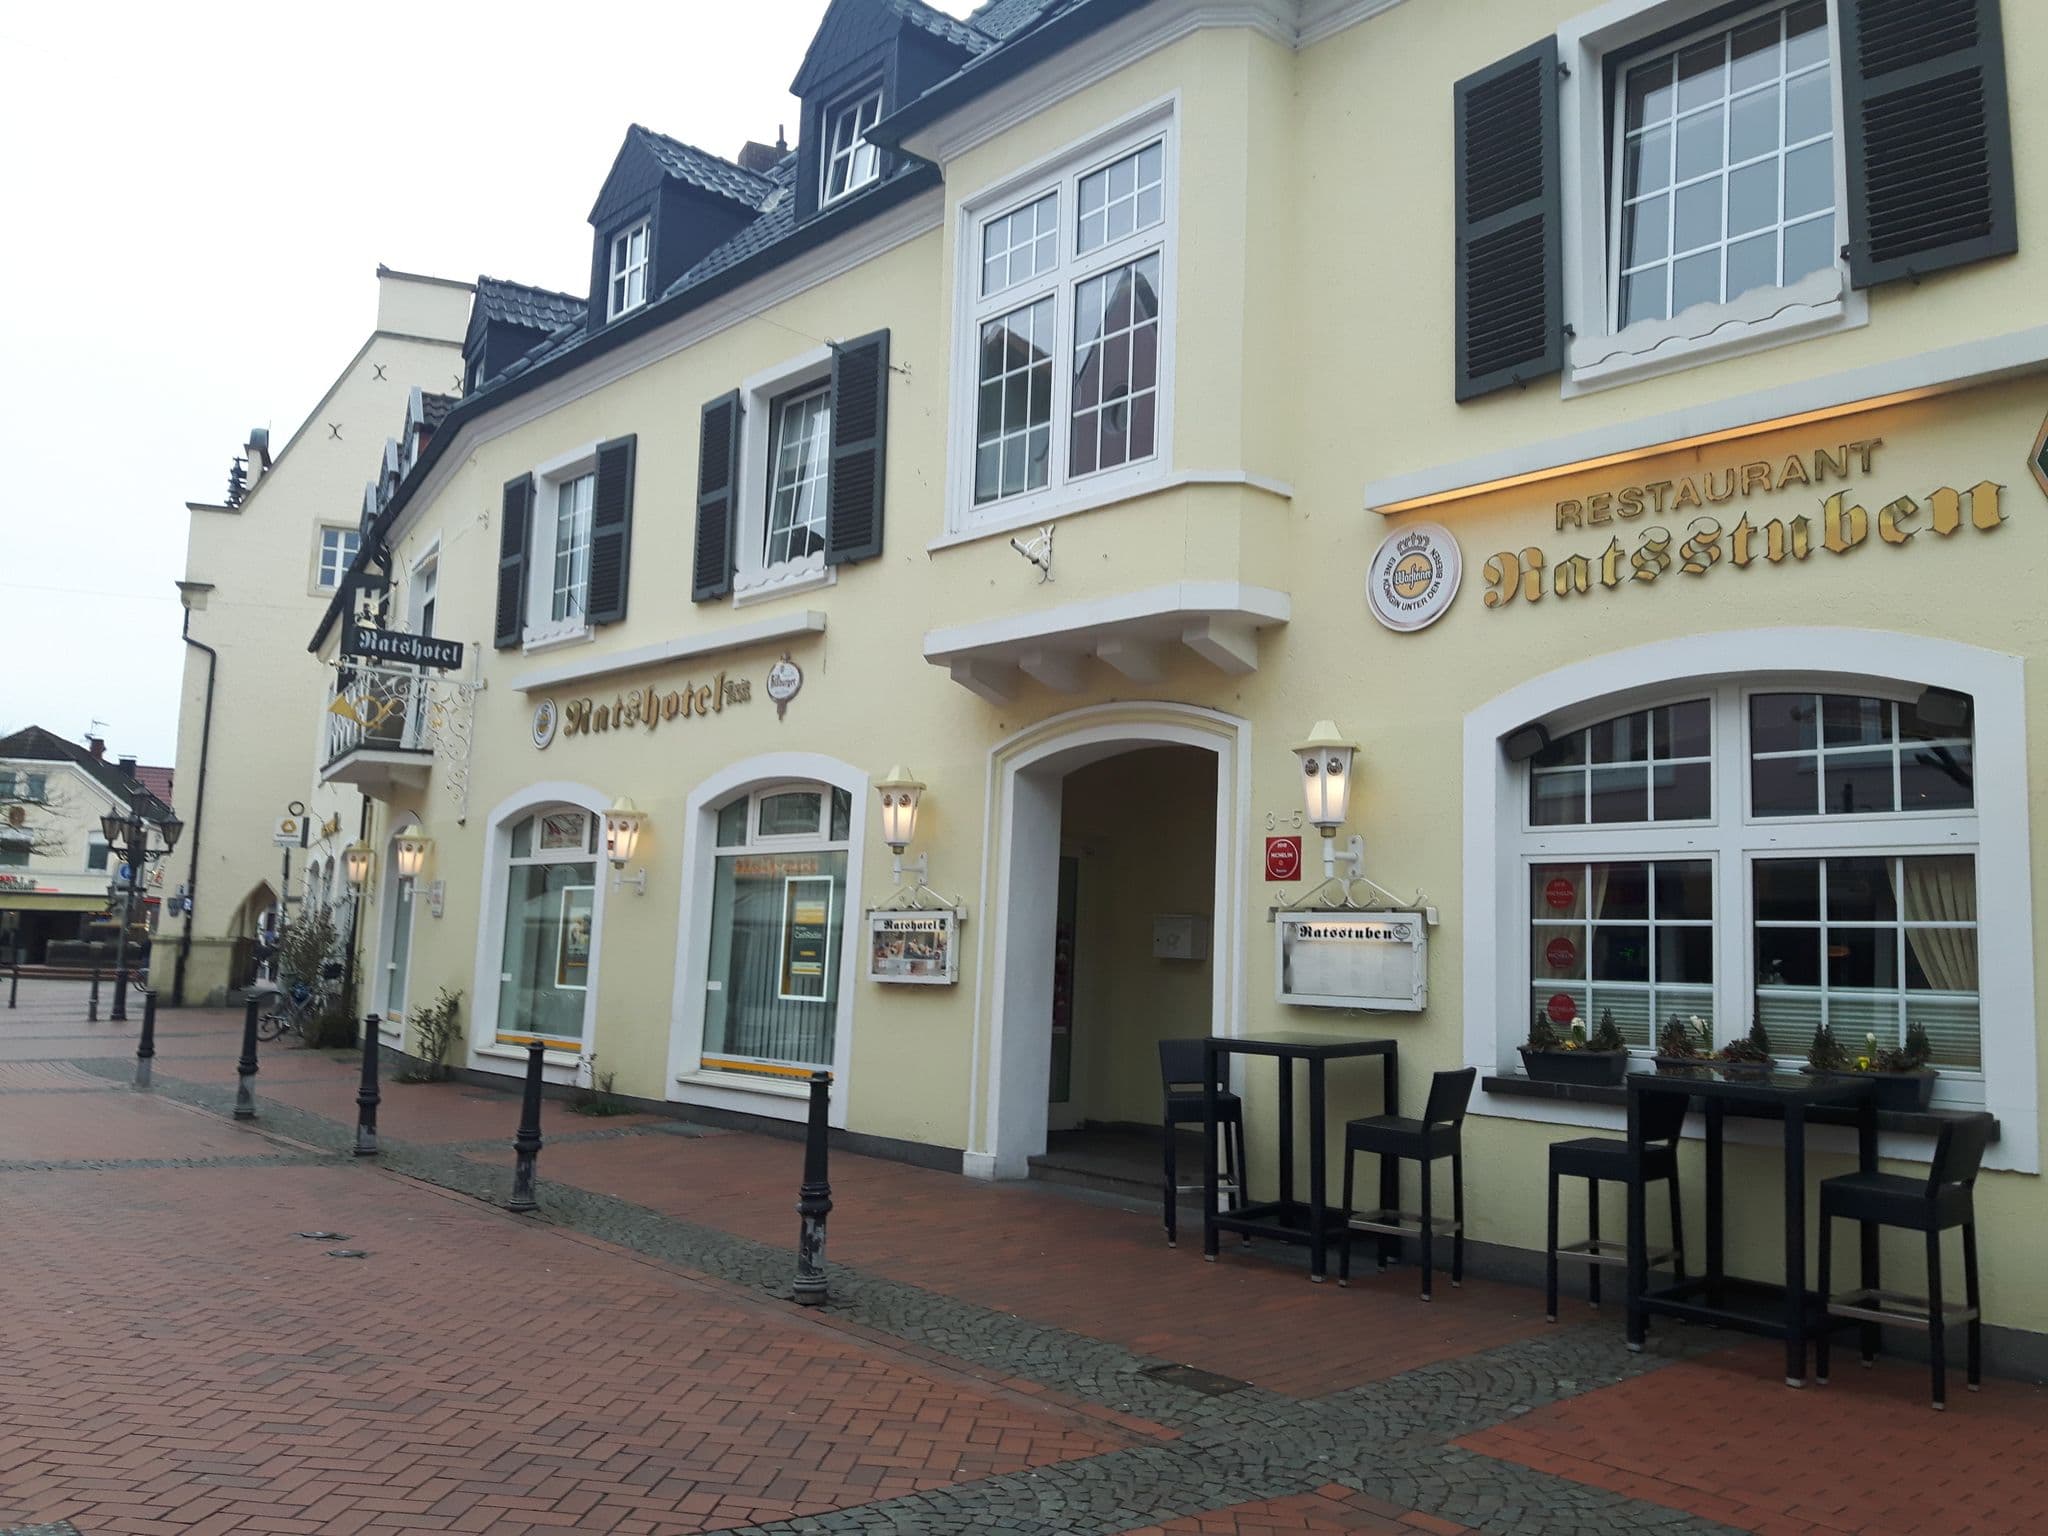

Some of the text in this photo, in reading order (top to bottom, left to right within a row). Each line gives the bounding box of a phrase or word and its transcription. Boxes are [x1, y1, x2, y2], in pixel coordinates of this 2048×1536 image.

[1555, 437, 1884, 531] RESTAURANT
[1481, 479, 2010, 609] Ratsstuben
[1383, 556, 1397, 577] EINE
[1401, 598, 1429, 611] UNTER
[1427, 580, 1442, 600] DEN
[359, 630, 458, 663] Ratshotel
[563, 668, 727, 736] Ratshotel
[883, 919, 937, 931] Ratshotel
[1299, 925, 1392, 940] Ratsstuben
